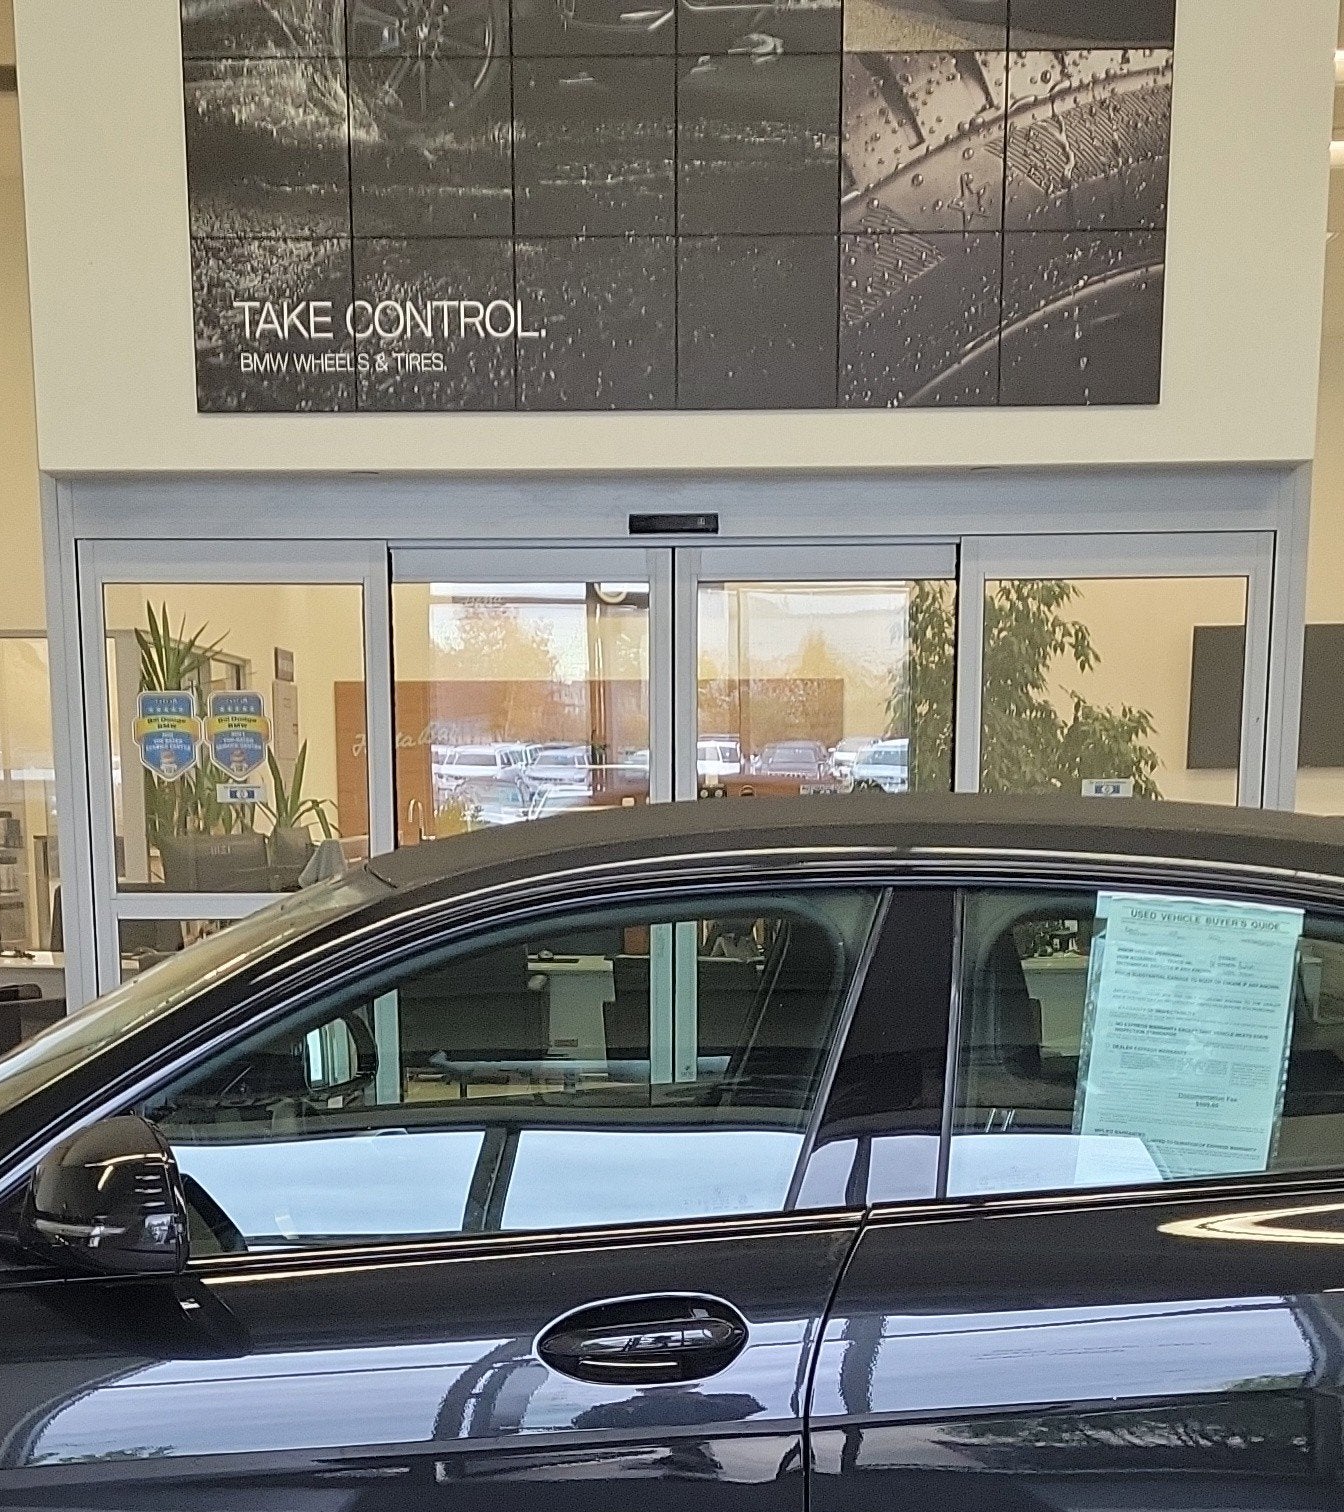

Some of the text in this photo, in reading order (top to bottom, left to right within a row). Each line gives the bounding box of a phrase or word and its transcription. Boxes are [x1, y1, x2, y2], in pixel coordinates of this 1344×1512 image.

[233, 298, 547, 341] TAKE CONTROL.
[240, 351, 448, 373] BMW WHEELS & TIRES.
[1130, 908, 1280, 931] USED VEHICLE BUYER'S GUIDE
